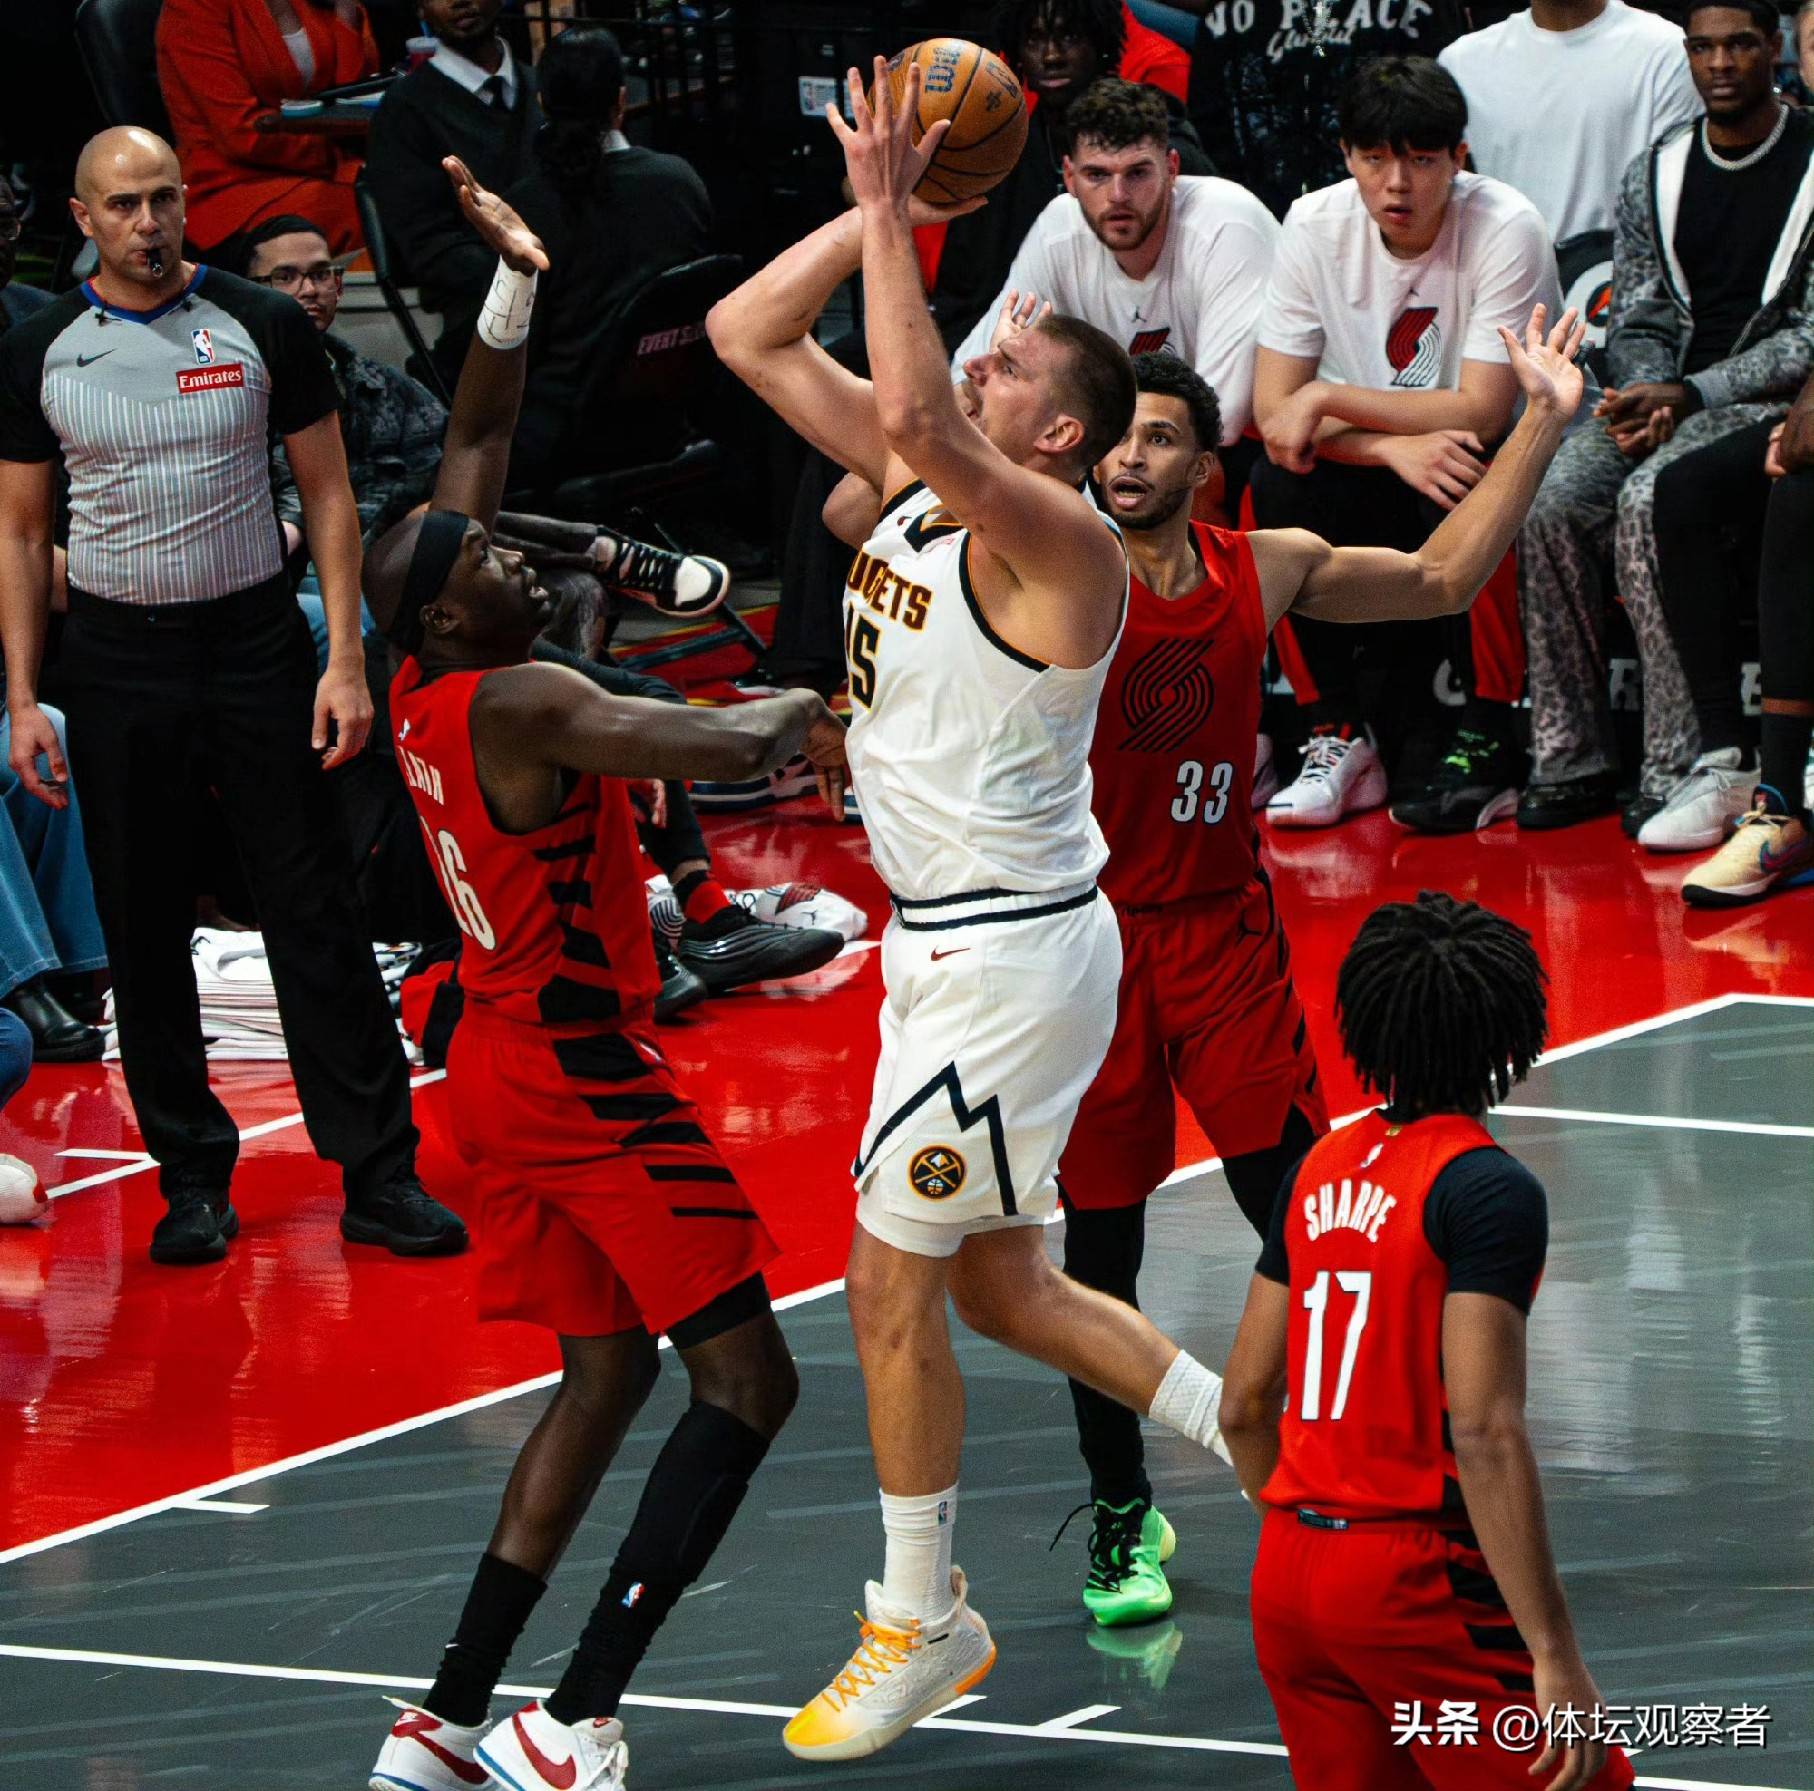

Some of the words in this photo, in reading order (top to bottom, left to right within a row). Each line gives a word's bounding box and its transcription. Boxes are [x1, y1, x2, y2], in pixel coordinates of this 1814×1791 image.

[179, 369, 242, 389] Emirates
[1171, 760, 1233, 824] 33
[1303, 1178, 1398, 1243] SHARPE
[1301, 1271, 1372, 1421] 17
